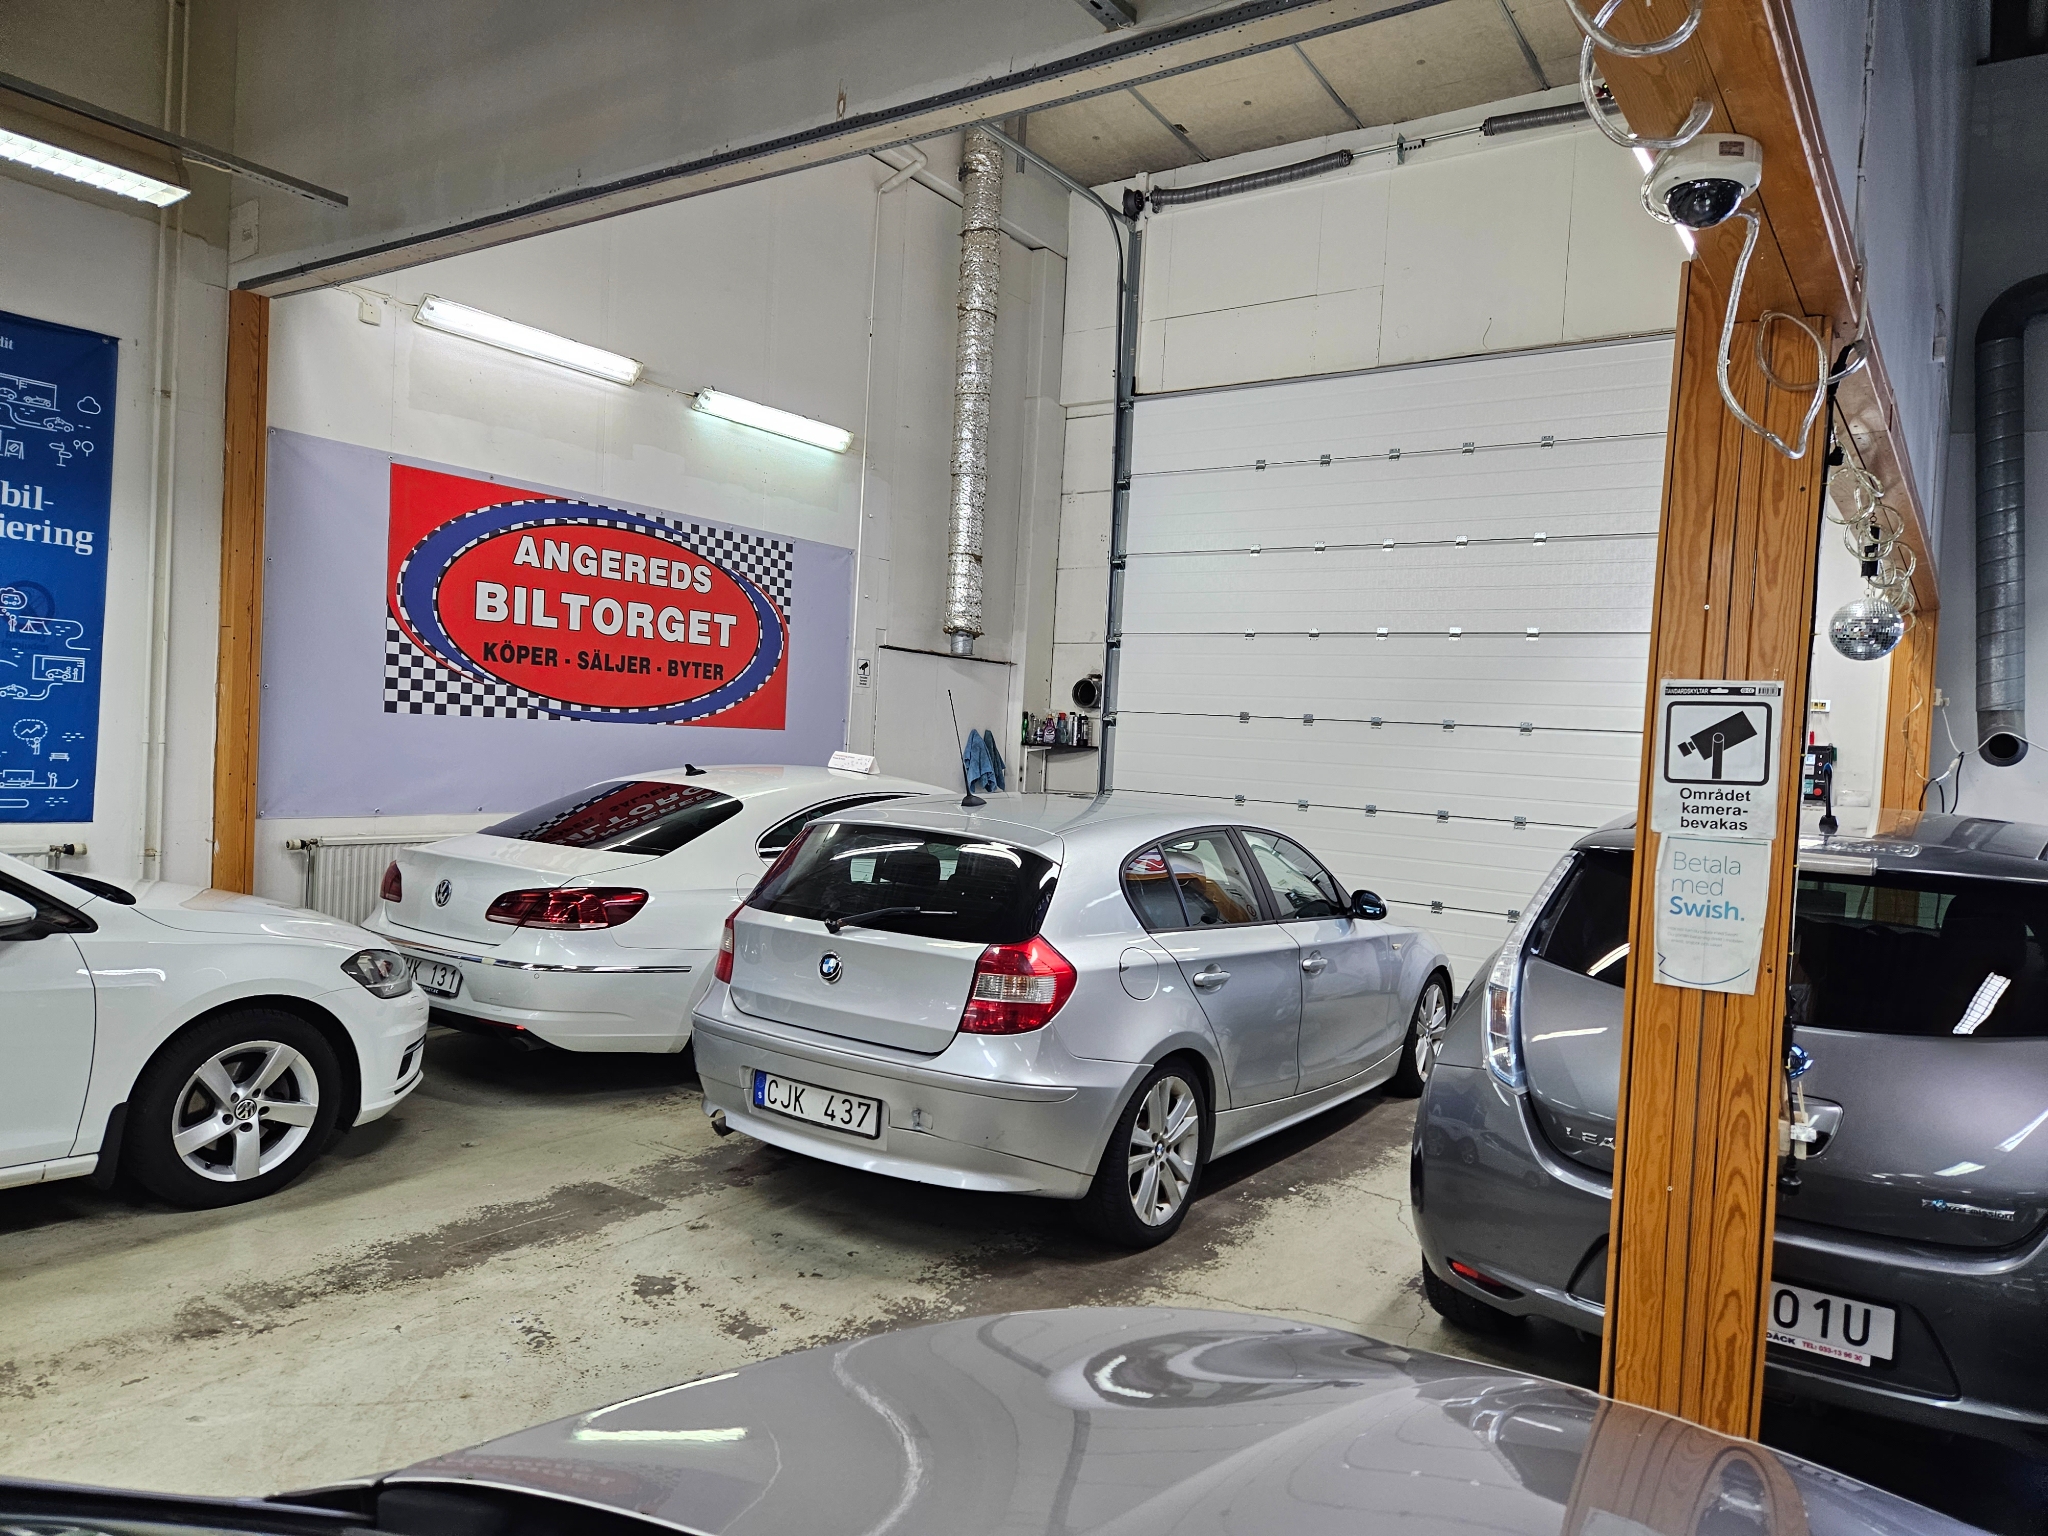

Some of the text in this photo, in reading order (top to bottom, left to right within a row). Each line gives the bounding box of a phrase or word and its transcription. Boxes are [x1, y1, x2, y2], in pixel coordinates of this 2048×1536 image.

[1, 480, 55, 511] bil-
[513, 535, 713, 594] ANGEREDS
[475, 580, 737, 648] BILTORGET
[483, 640, 558, 667] KÖPER
[577, 649, 651, 675] SÄLJER
[667, 659, 724, 681] BYTER
[1680, 787, 1751, 802] Området
[1682, 802, 1748, 816] kamera-
[1680, 816, 1748, 831] bevakas
[1673, 851, 1741, 876] Betala
[1671, 877, 1724, 896] med
[1669, 895, 1745, 922] Swish.
[431, 964, 457, 990] 131
[767, 1079, 871, 1128] CJK 437
[1773, 1288, 1871, 1347] 01U
[1802, 1340, 1817, 1350] TEL:
